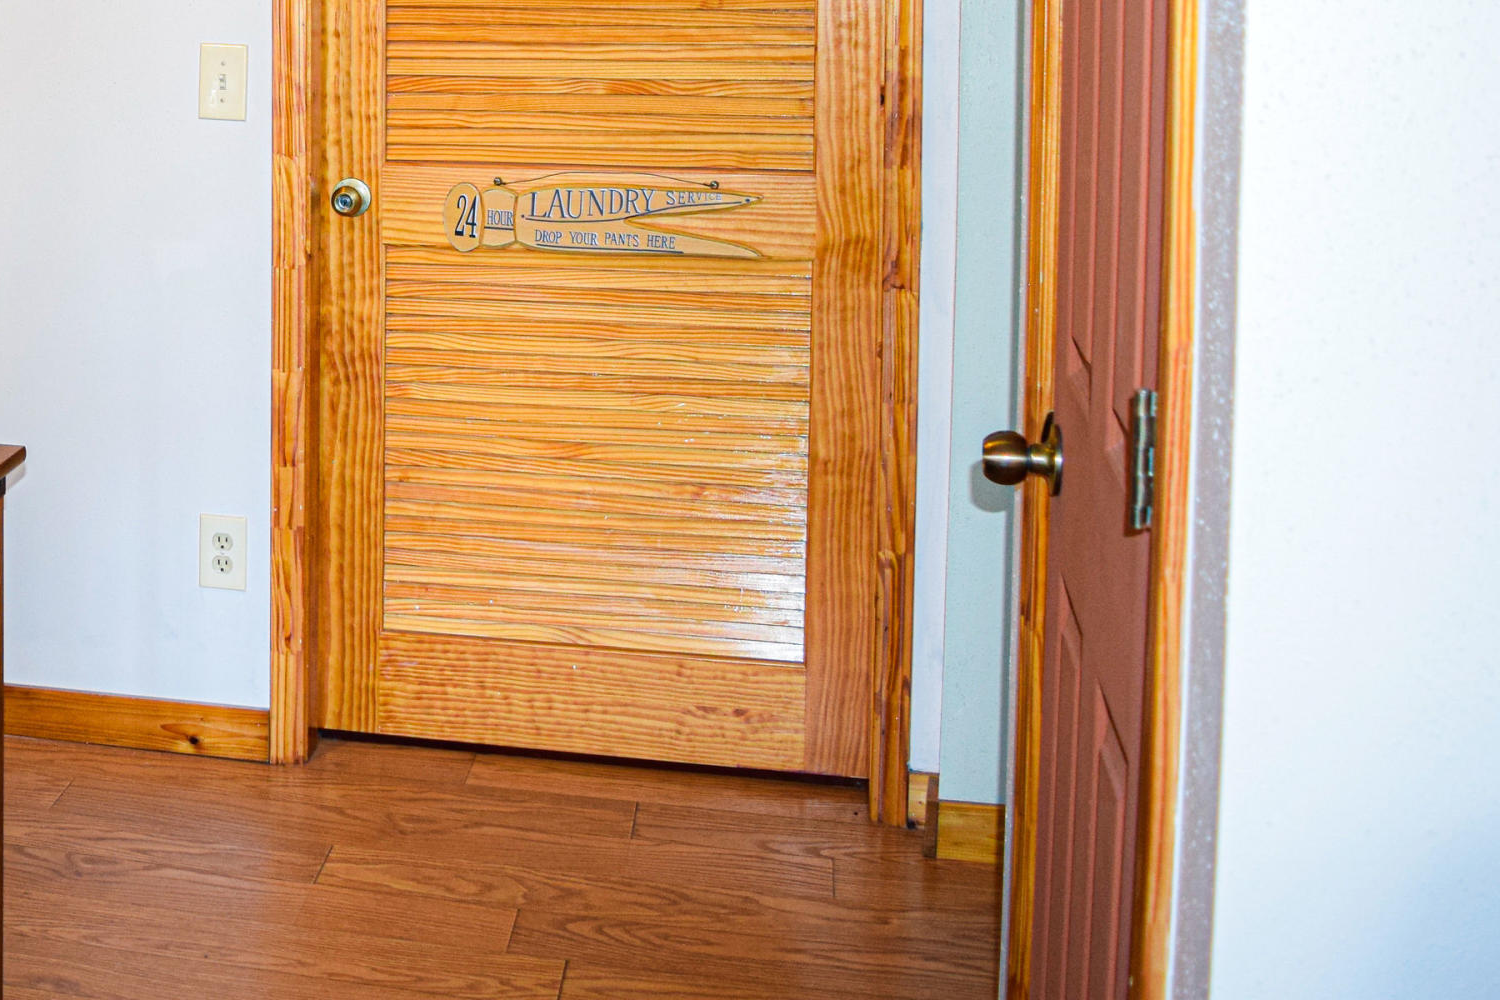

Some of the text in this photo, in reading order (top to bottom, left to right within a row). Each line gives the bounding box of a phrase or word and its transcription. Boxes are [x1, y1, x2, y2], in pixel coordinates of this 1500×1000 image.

[454, 194, 477, 238] 24
[530, 187, 723, 219] LAUNDRY SERVICE
[486, 208, 514, 227] HOUR
[534, 229, 676, 249] DROP YOUR PANTS HERE
